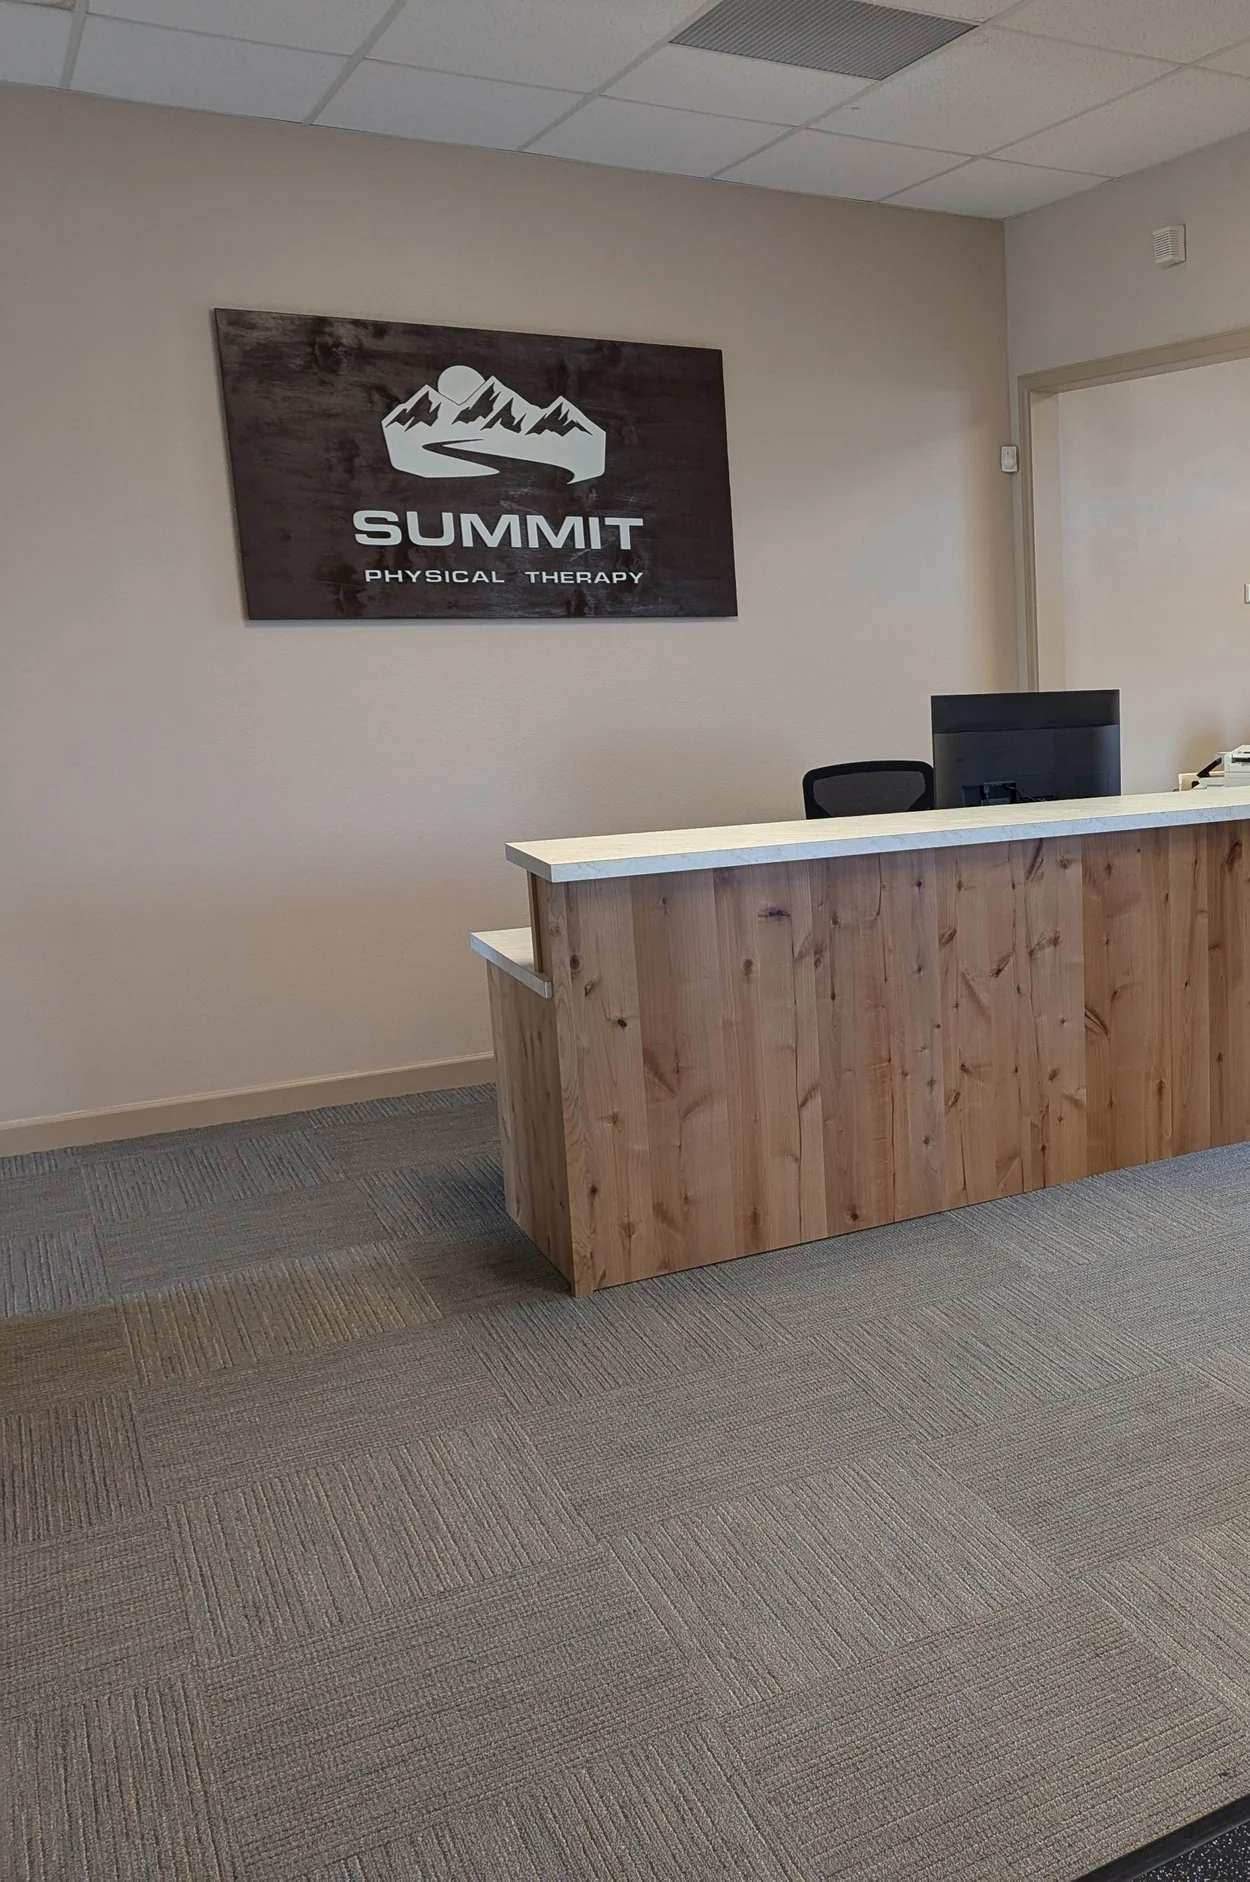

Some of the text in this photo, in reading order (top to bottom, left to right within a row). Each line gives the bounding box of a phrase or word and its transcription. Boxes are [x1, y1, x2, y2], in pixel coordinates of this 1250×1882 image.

[352, 510, 644, 550] SUMMIT
[364, 569, 644, 584] PHYSICAL THERAPY
